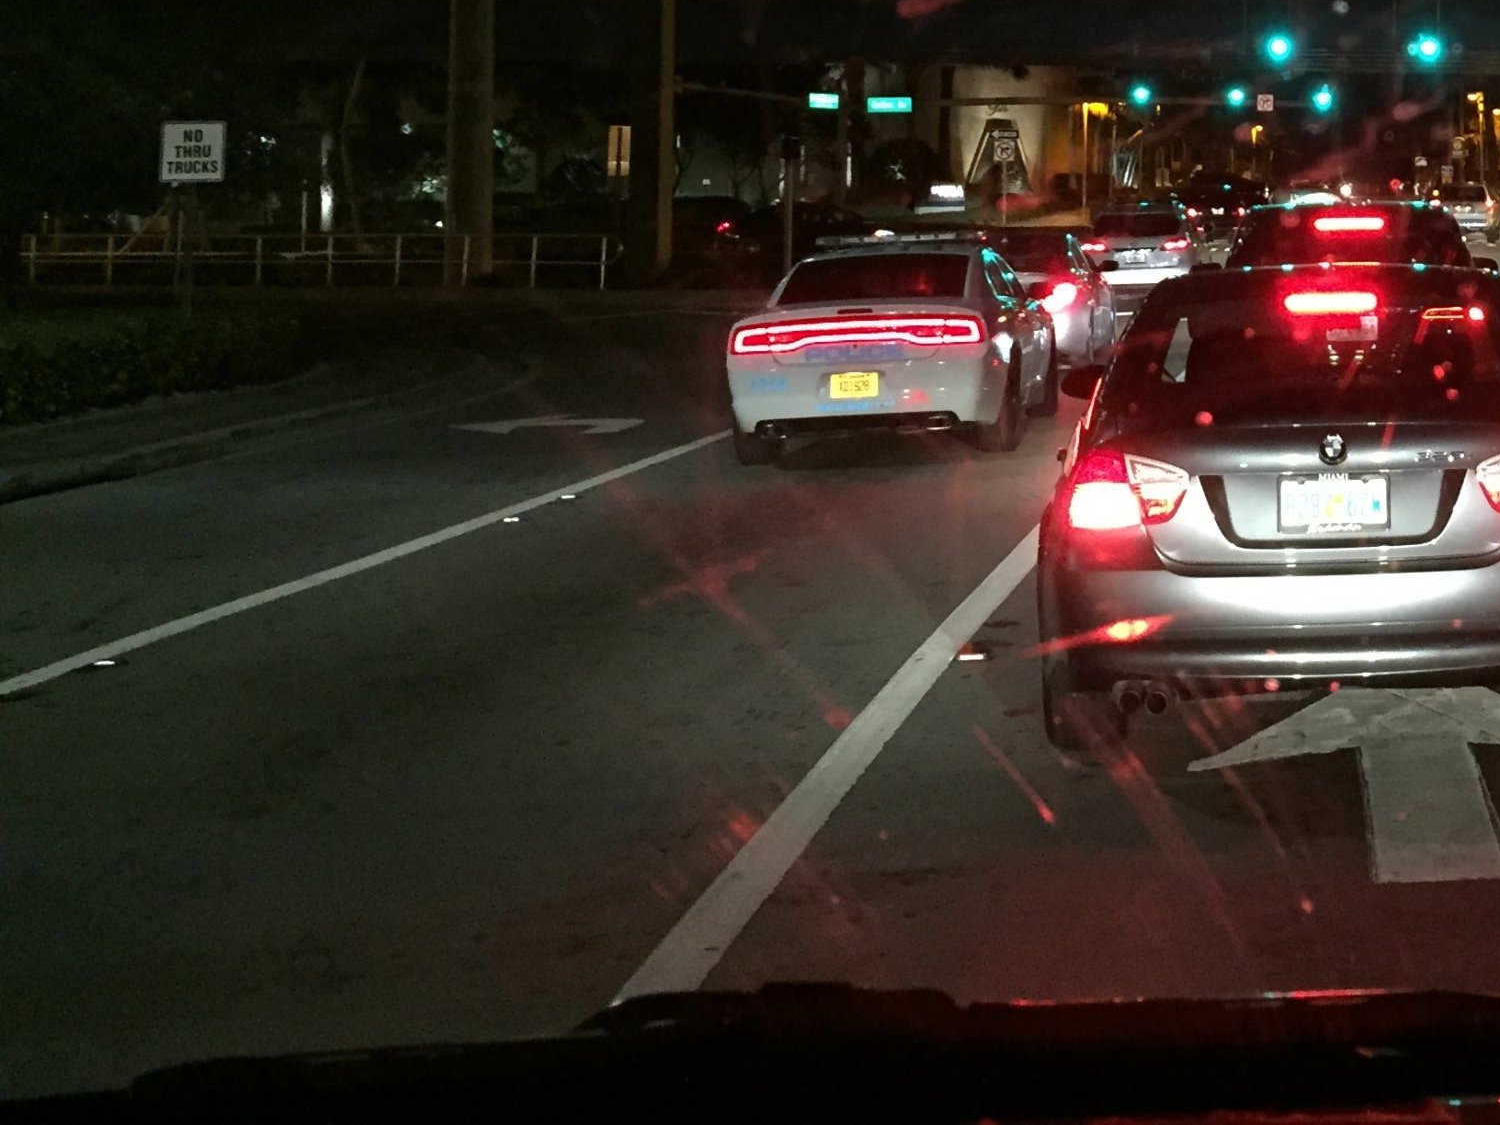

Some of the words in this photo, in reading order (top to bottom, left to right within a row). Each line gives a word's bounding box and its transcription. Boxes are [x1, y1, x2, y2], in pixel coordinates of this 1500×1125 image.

[183, 129, 204, 143] NO
[174, 145, 212, 159] THRU
[166, 160, 219, 174] TRUCKS
[1318, 473, 1350, 482] MIAMI
